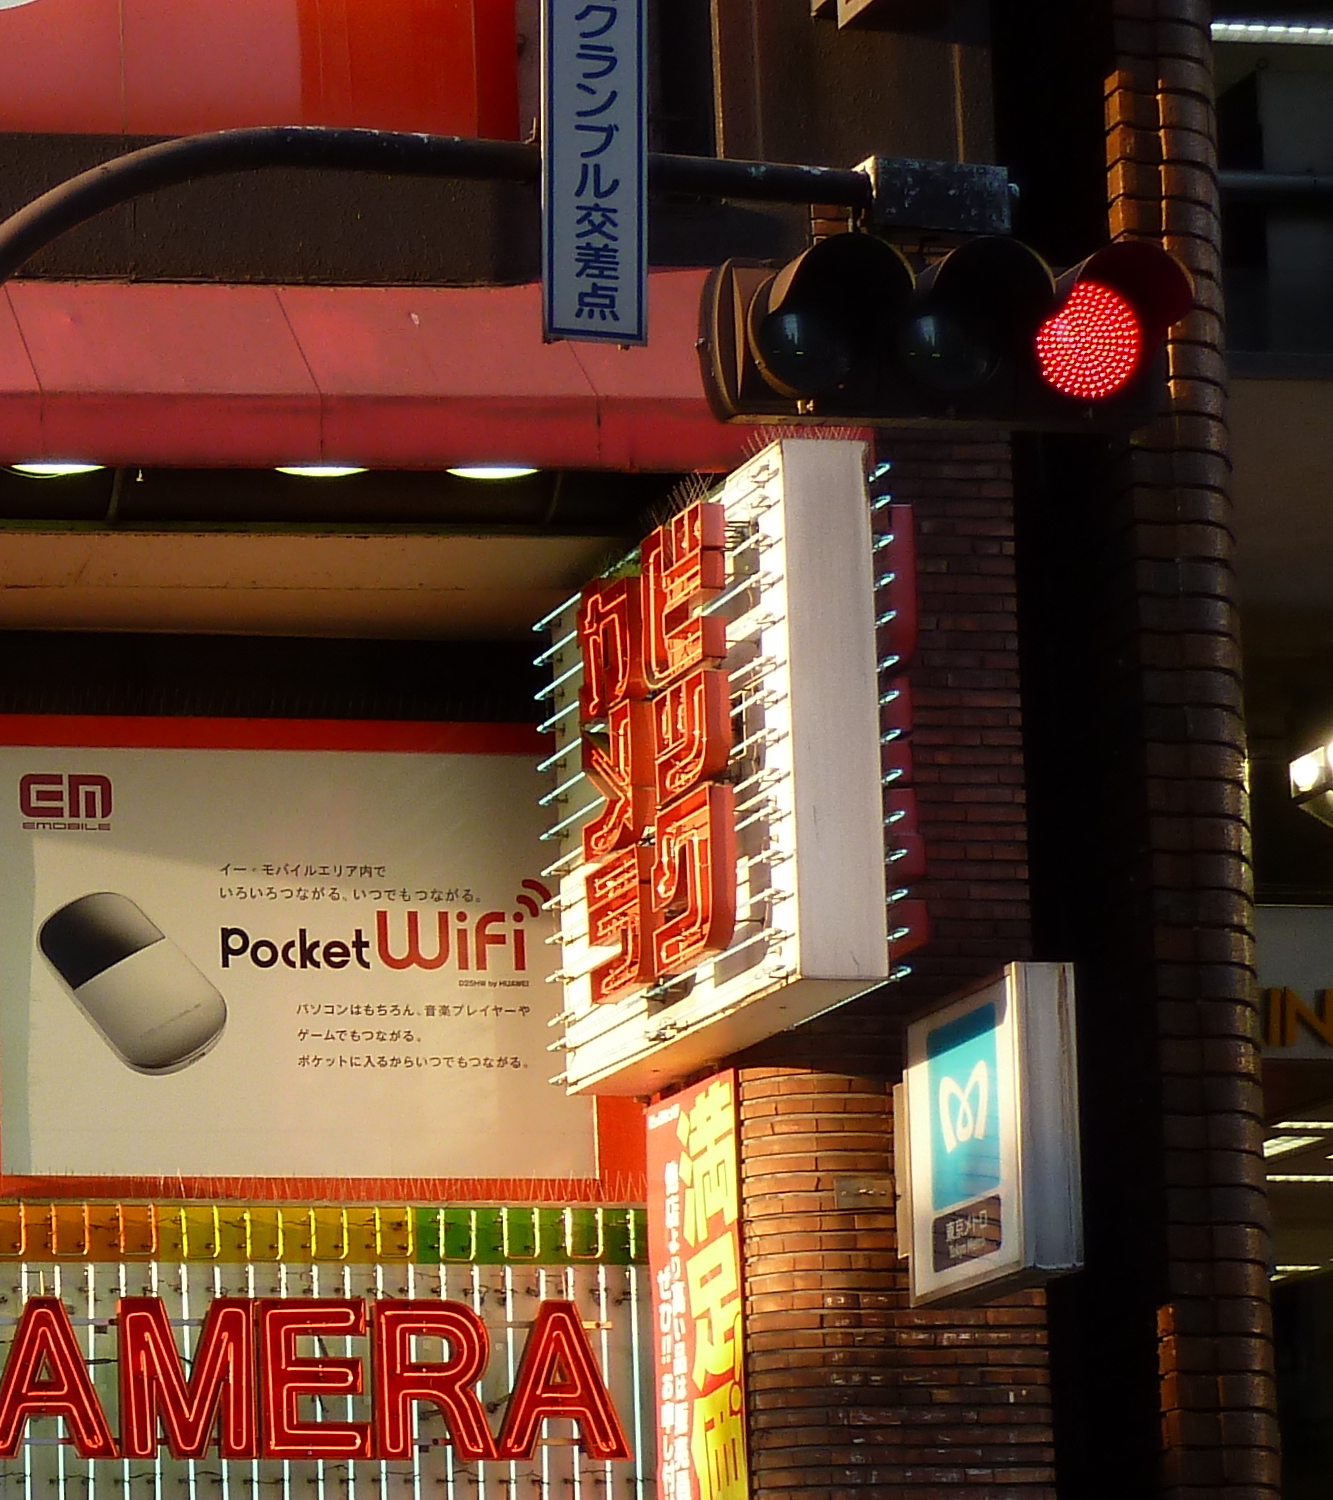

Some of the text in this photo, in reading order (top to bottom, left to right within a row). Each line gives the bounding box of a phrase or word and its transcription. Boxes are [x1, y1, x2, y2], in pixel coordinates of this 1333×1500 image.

[21, 821, 111, 831] EMOBILE
[219, 862, 387, 880] イー・モバイルエリア内で
[219, 885, 483, 905] いろいろつながる、いつでもつながる。
[500, 979, 530, 987] HUAWEI
[296, 1003, 531, 1018] パソコンはもちろん、音楽プレイヤーや
[296, 1027, 423, 1044] ゲームでもつながる。
[296, 1054, 531, 1069] ポケットに入るからいつでもつながる。
